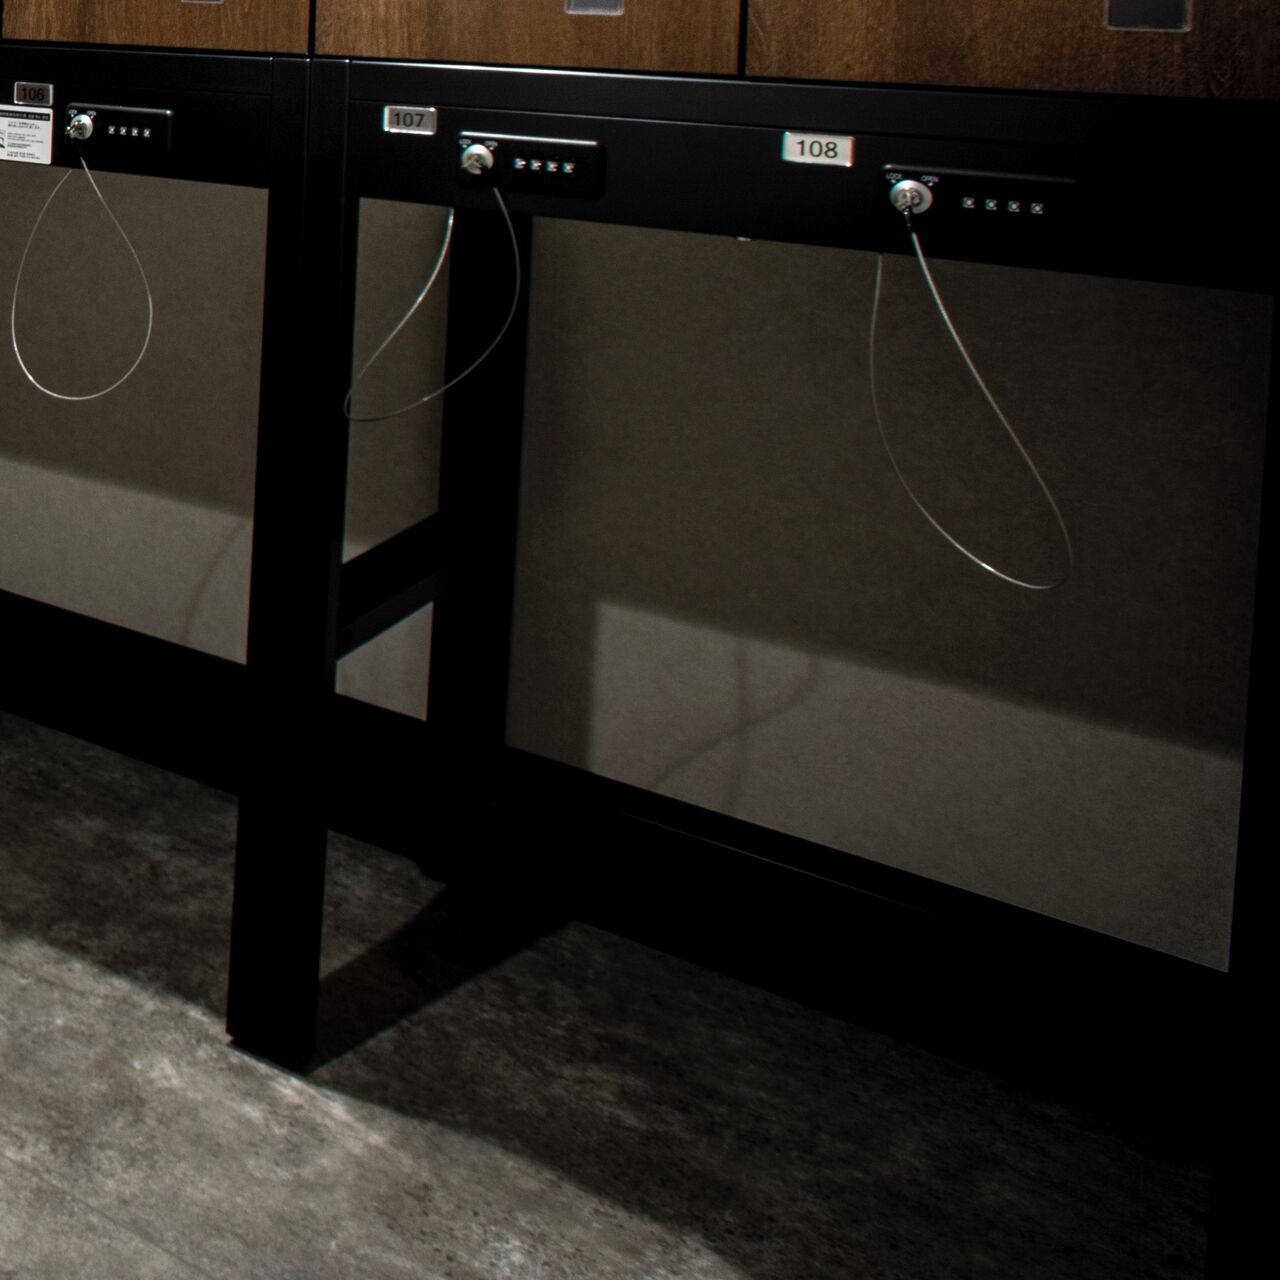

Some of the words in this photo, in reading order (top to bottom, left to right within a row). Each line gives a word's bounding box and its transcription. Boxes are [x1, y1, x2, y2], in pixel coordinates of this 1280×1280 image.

[21, 87, 44, 101] 106
[393, 112, 425, 127] 107
[796, 140, 838, 159] 108
